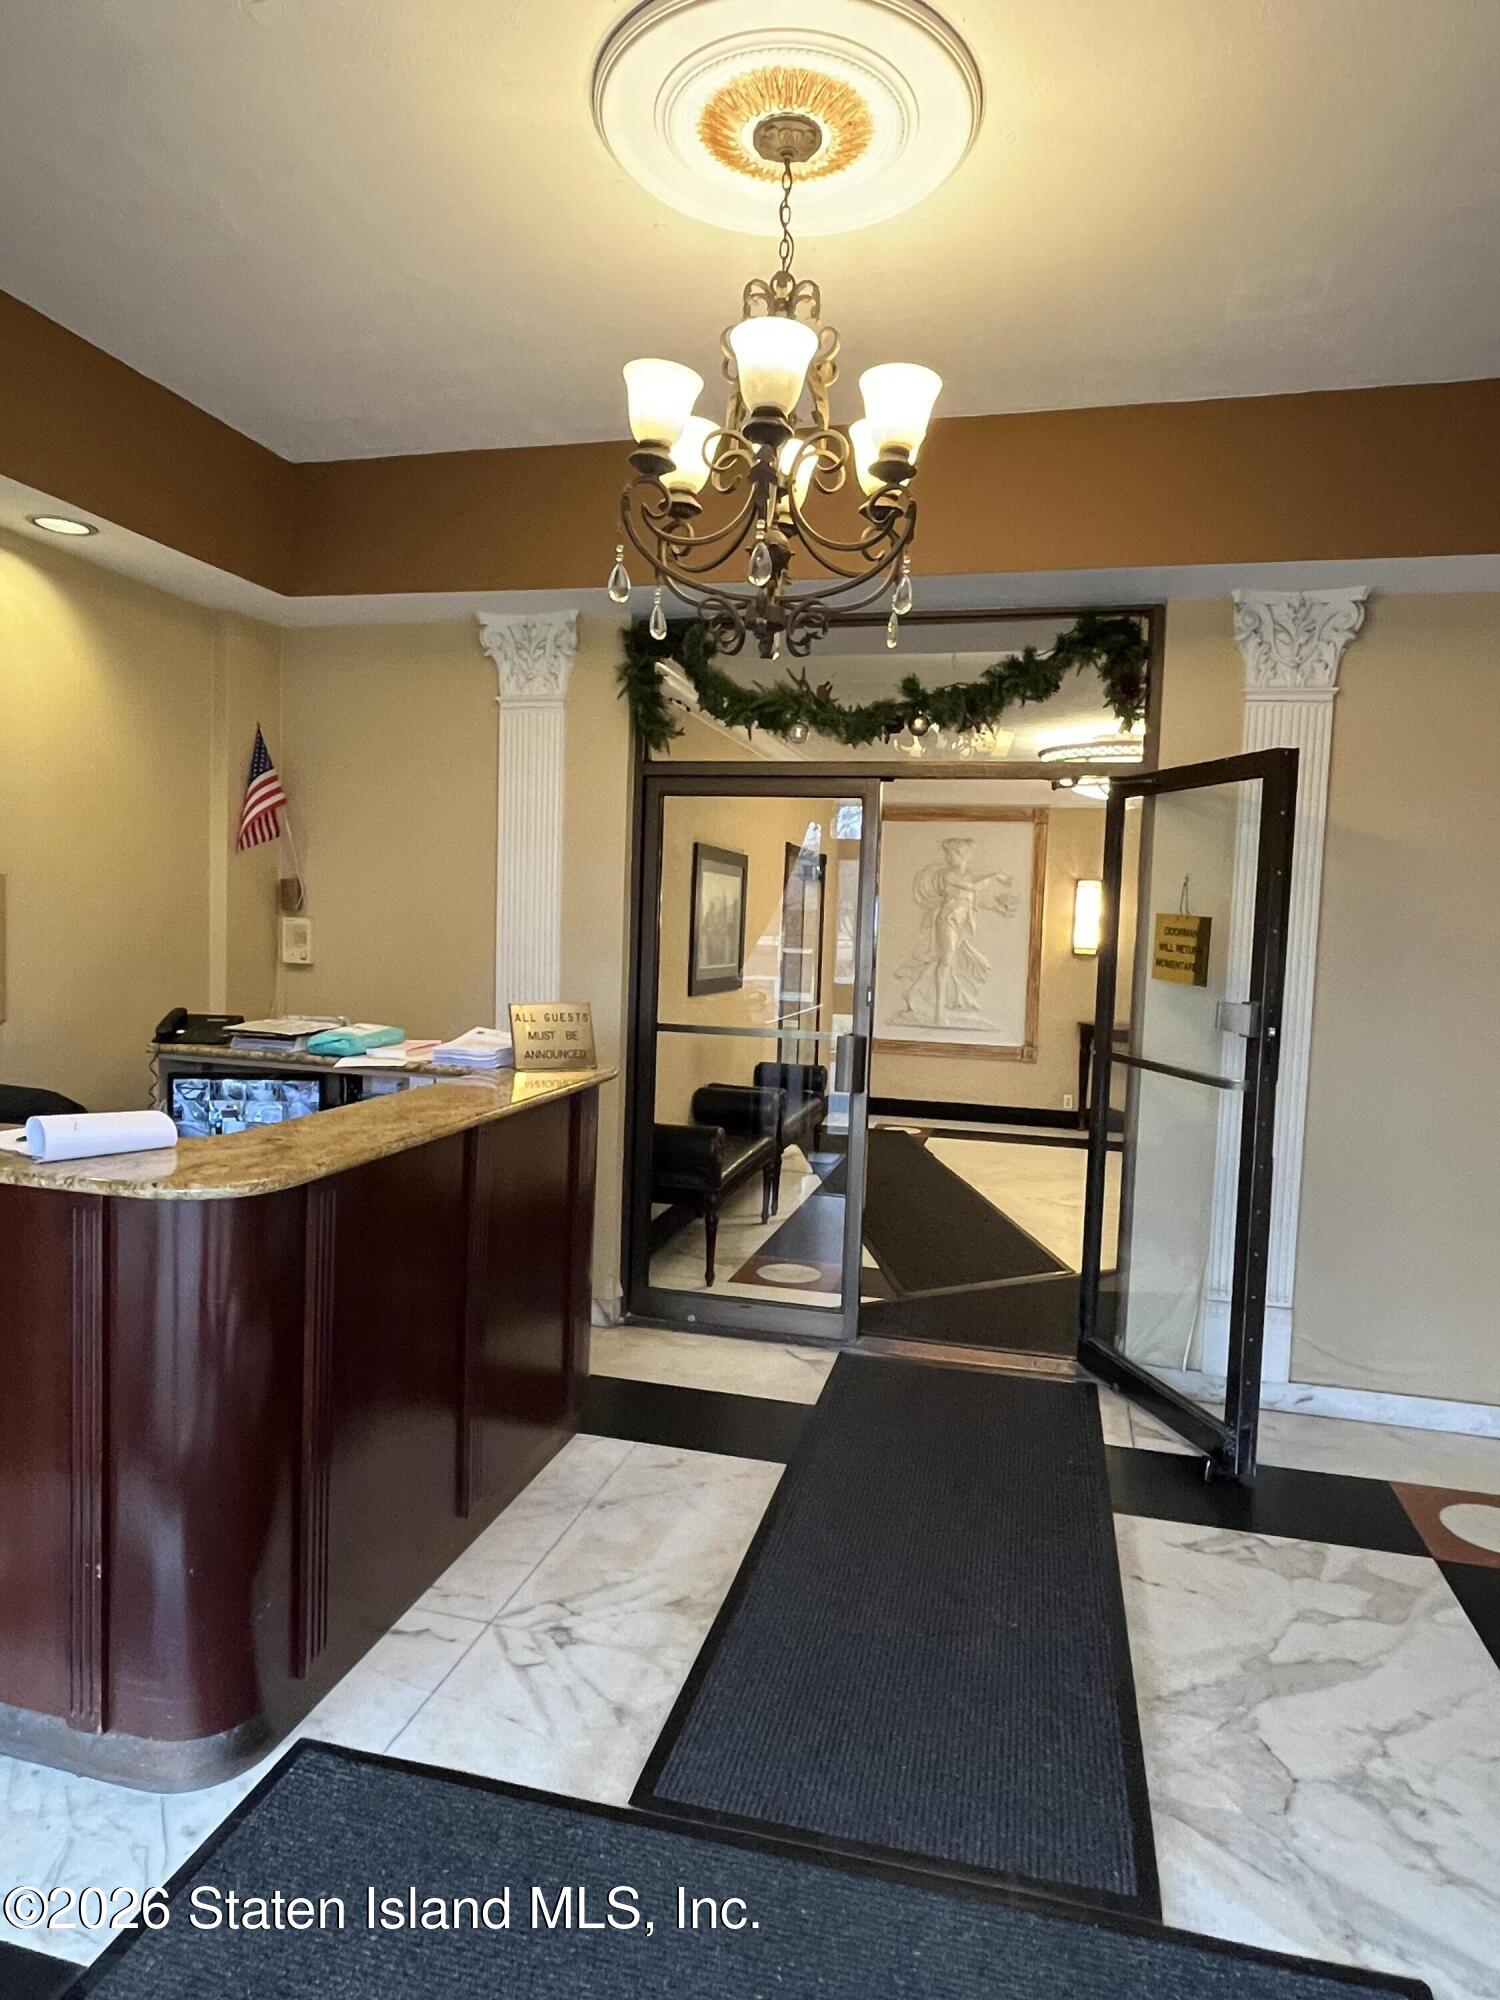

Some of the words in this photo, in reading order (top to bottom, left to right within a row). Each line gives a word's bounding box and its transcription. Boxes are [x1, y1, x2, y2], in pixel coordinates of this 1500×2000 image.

[1159, 943, 1174, 953] WILL
[514, 1012, 537, 1023] ALL
[543, 1012, 589, 1023] GUESTS
[527, 1030, 556, 1041] MUST
[565, 1030, 579, 1041] BE
[524, 1048, 587, 1060] ANNOUNCED
